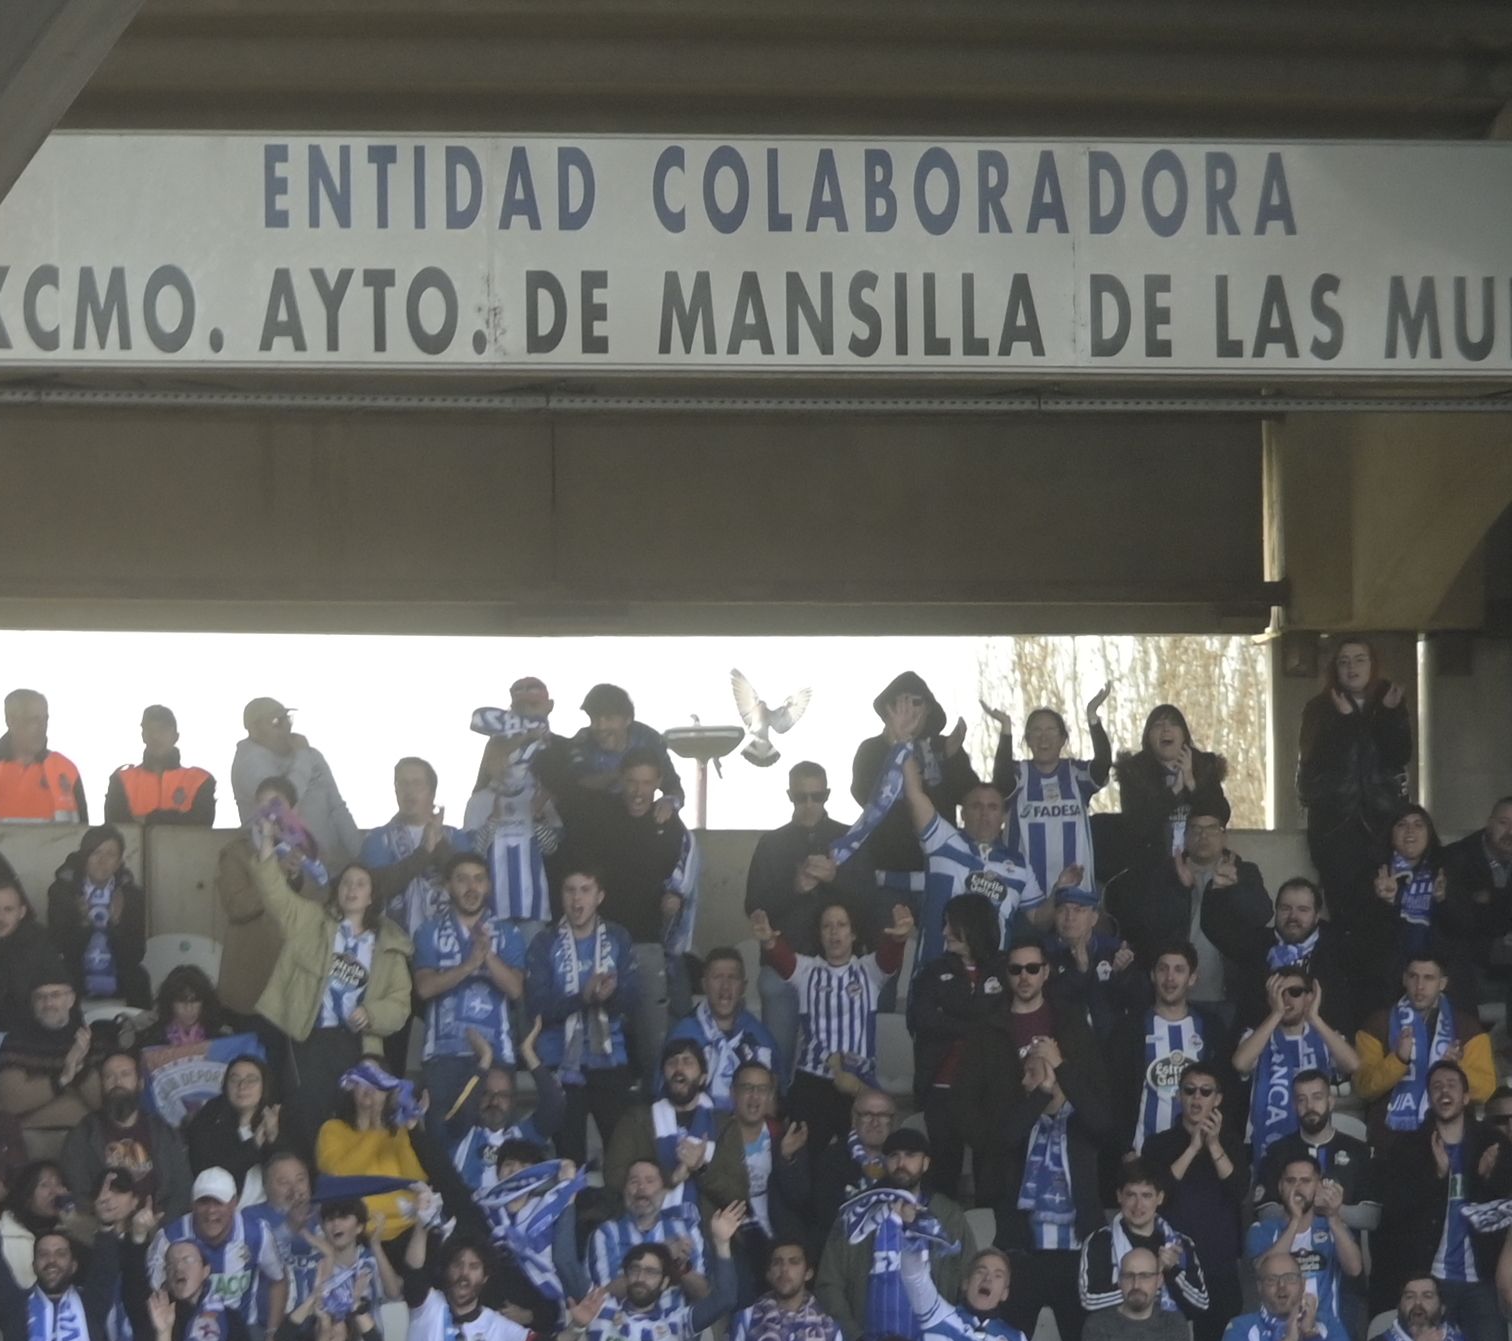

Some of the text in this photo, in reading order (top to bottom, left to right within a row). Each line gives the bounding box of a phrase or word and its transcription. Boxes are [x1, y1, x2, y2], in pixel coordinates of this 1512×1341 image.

[264, 142, 1297, 239] ENTIDAD COLABORADORA
[260, 266, 489, 356] AYTO.
[525, 268, 612, 354] DE
[657, 271, 1047, 359] MANSILLA
[1087, 272, 1176, 359] DE
[1216, 272, 1347, 361] LAS
[1033, 805, 1080, 818] FADESA
